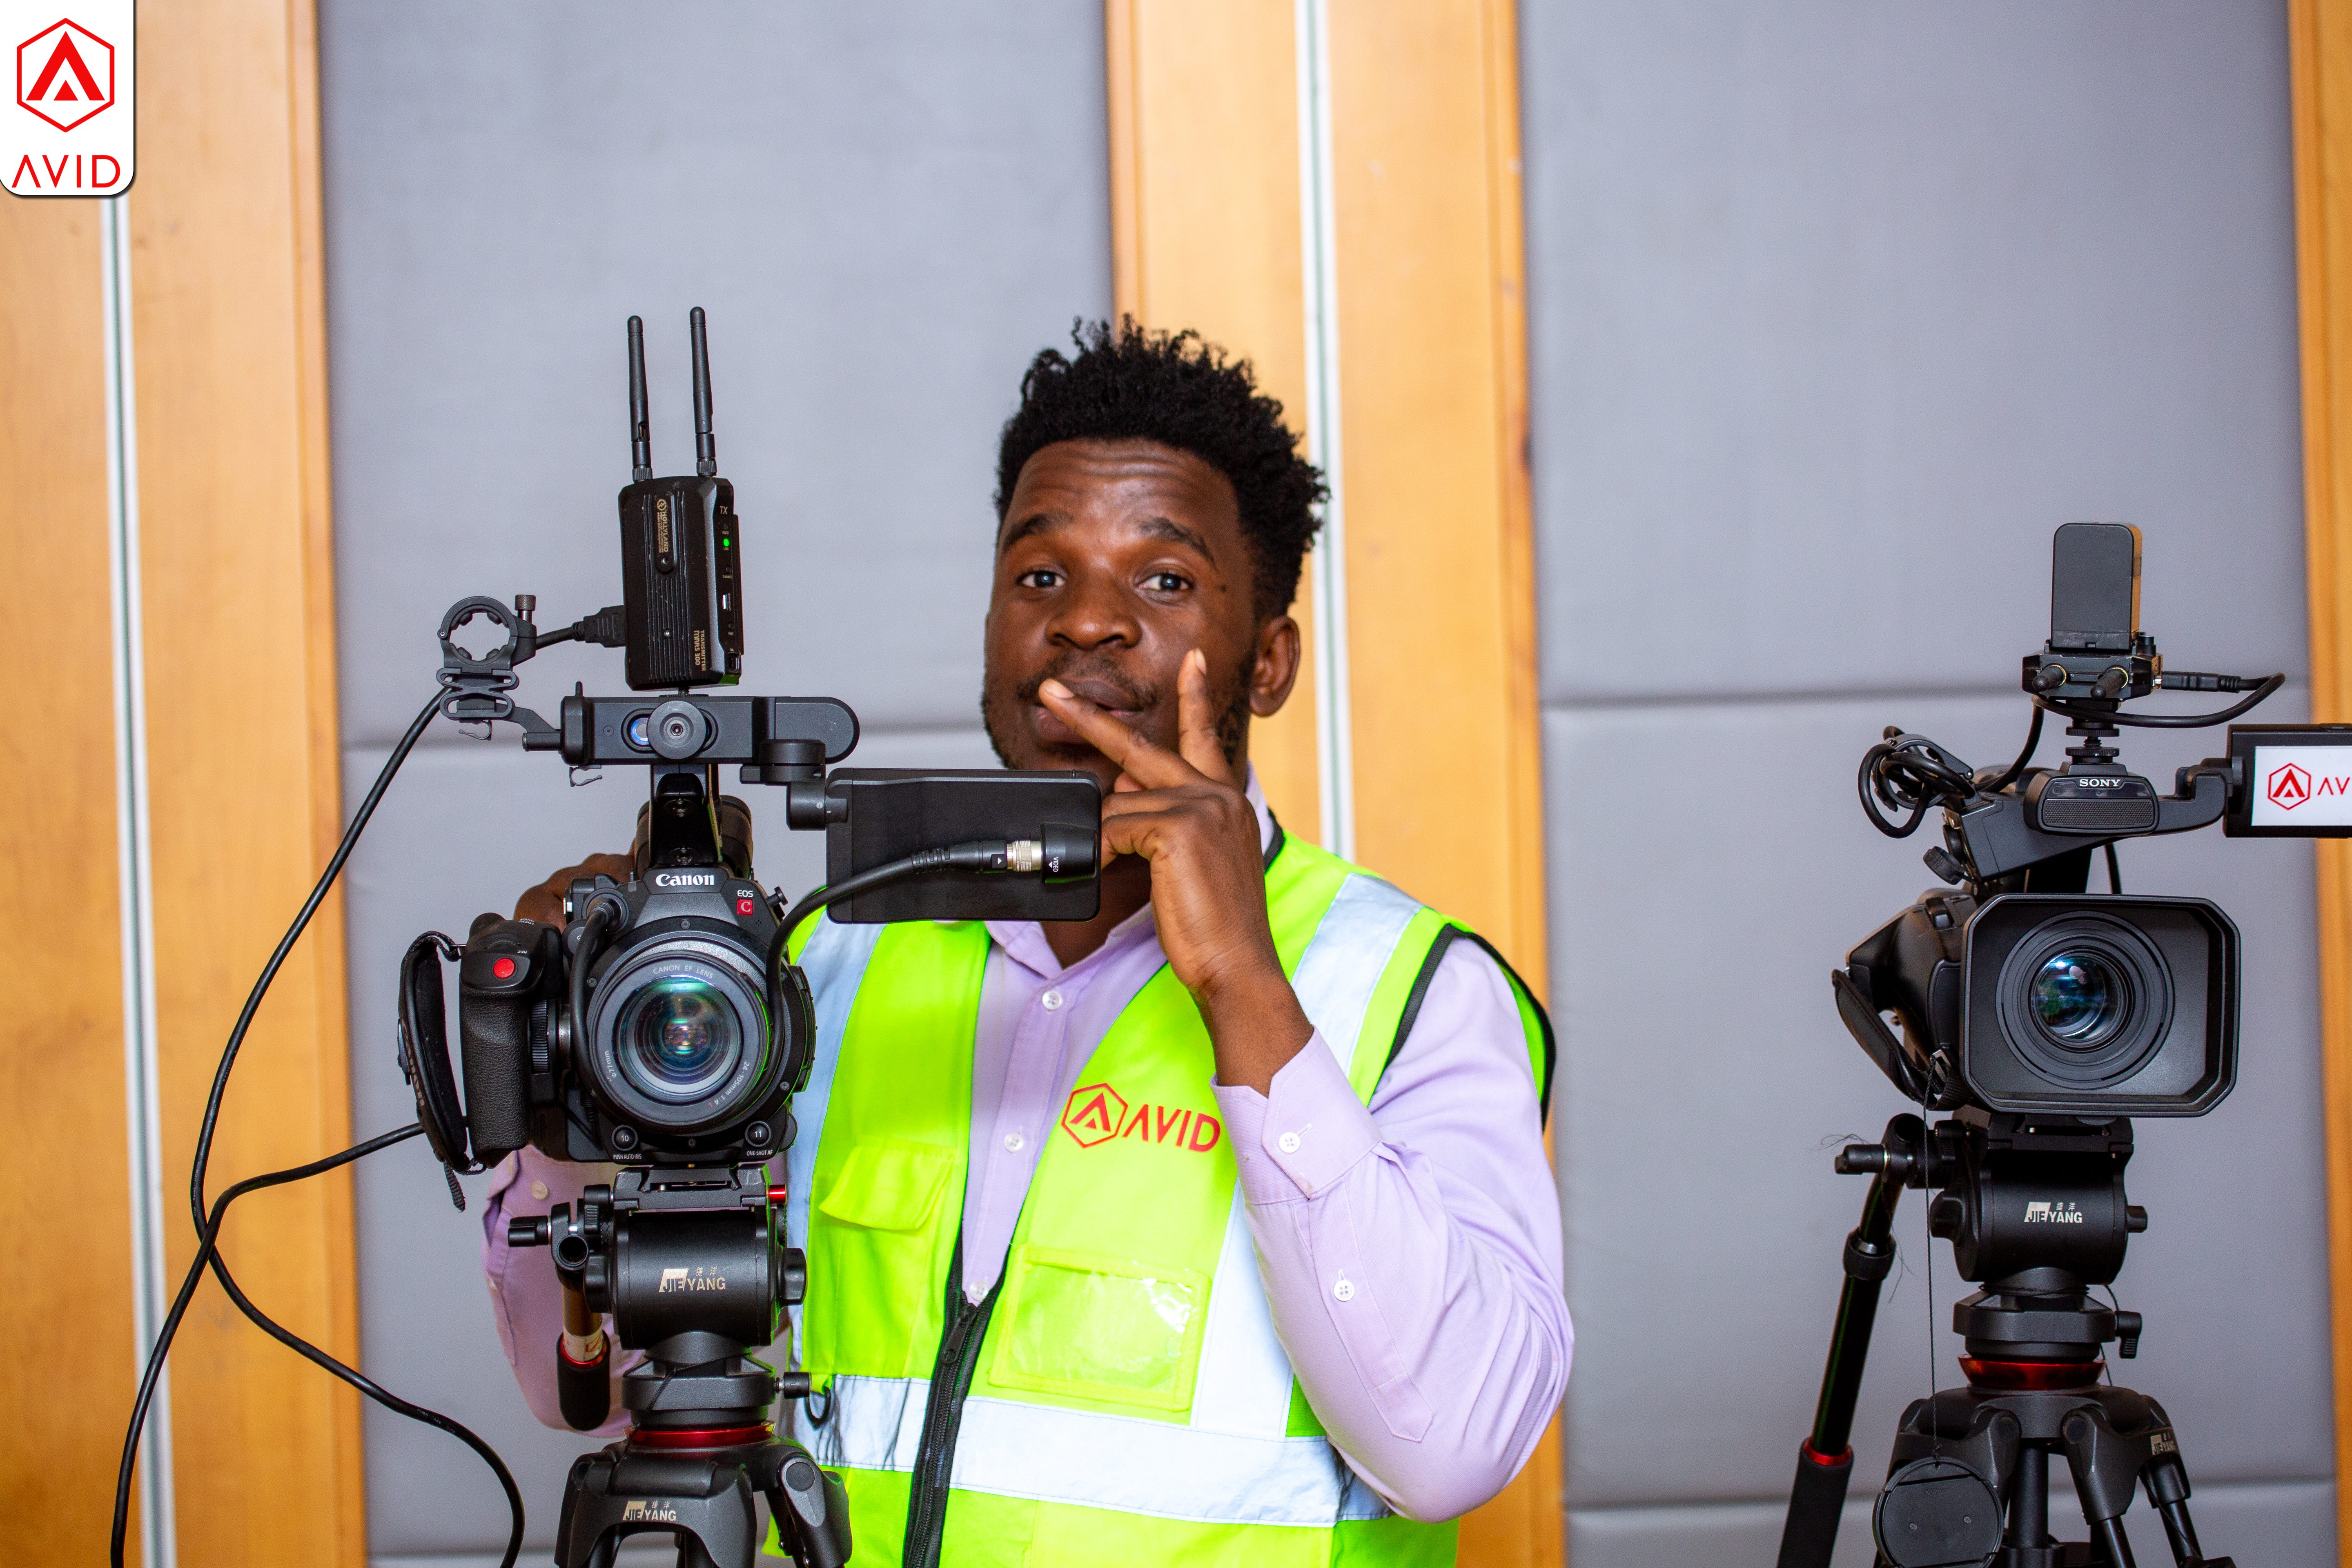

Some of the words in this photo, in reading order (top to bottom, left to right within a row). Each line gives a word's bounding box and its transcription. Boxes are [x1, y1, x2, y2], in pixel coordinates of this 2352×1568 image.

[719, 506, 728, 514] TX
[2079, 779, 2121, 787] SONY
[655, 874, 715, 886] Canon
[740, 902, 750, 912] C
[653, 965, 680, 974] CANON
[696, 968, 713, 979] LENS
[1121, 1104, 1221, 1153] AVID
[2025, 1211, 2082, 1223] JIEYANG
[660, 1277, 726, 1292] JIEYANG
[623, 1509, 677, 1521] JIEYANG
